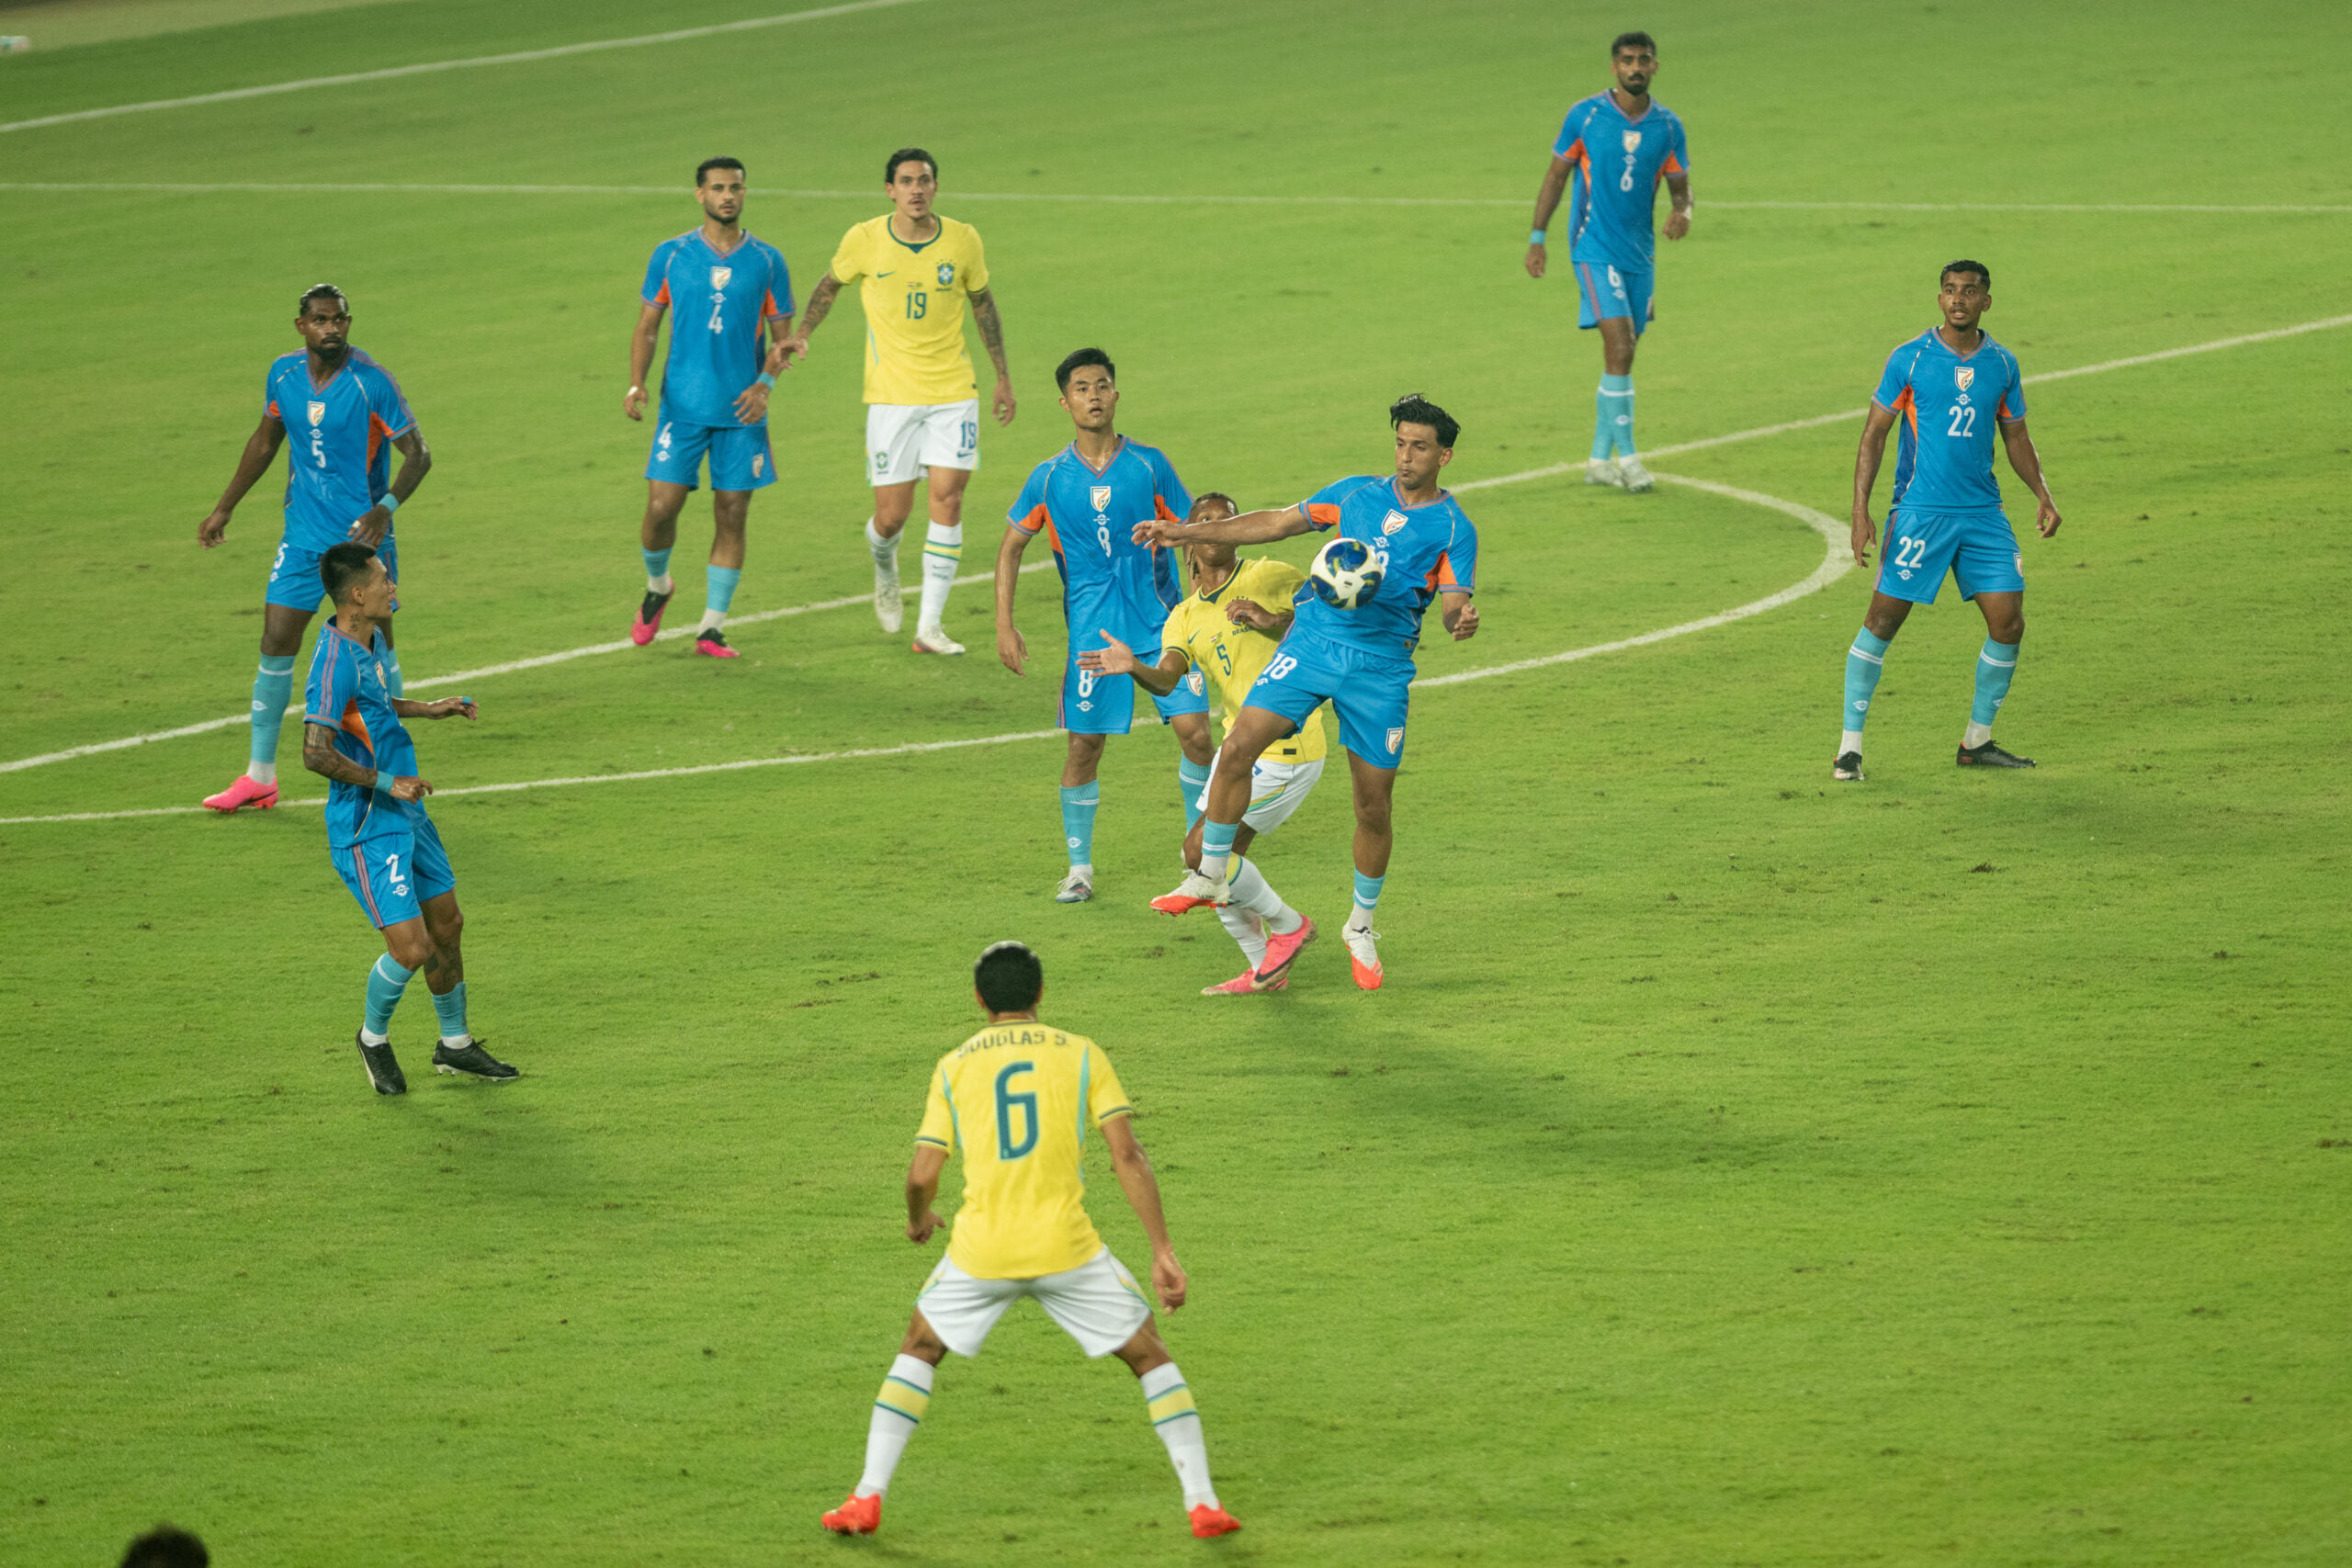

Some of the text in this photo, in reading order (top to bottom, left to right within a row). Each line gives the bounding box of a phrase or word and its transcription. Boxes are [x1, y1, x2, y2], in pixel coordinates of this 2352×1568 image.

[1620, 164, 1634, 192] 6
[1608, 264, 1622, 288] 6
[707, 304, 724, 334] 4
[907, 292, 927, 320] 19
[658, 422, 673, 449] 4
[961, 421, 978, 449] 19
[1948, 406, 1976, 437] 22
[312, 439, 327, 468] 5
[1097, 526, 1112, 558] 8
[1894, 536, 1926, 569] 22
[1216, 644, 1232, 676] 5
[1262, 653, 1298, 680] 18
[1079, 669, 1093, 698] 8
[386, 853, 405, 884] 2
[995, 1060, 1039, 1160] 6
